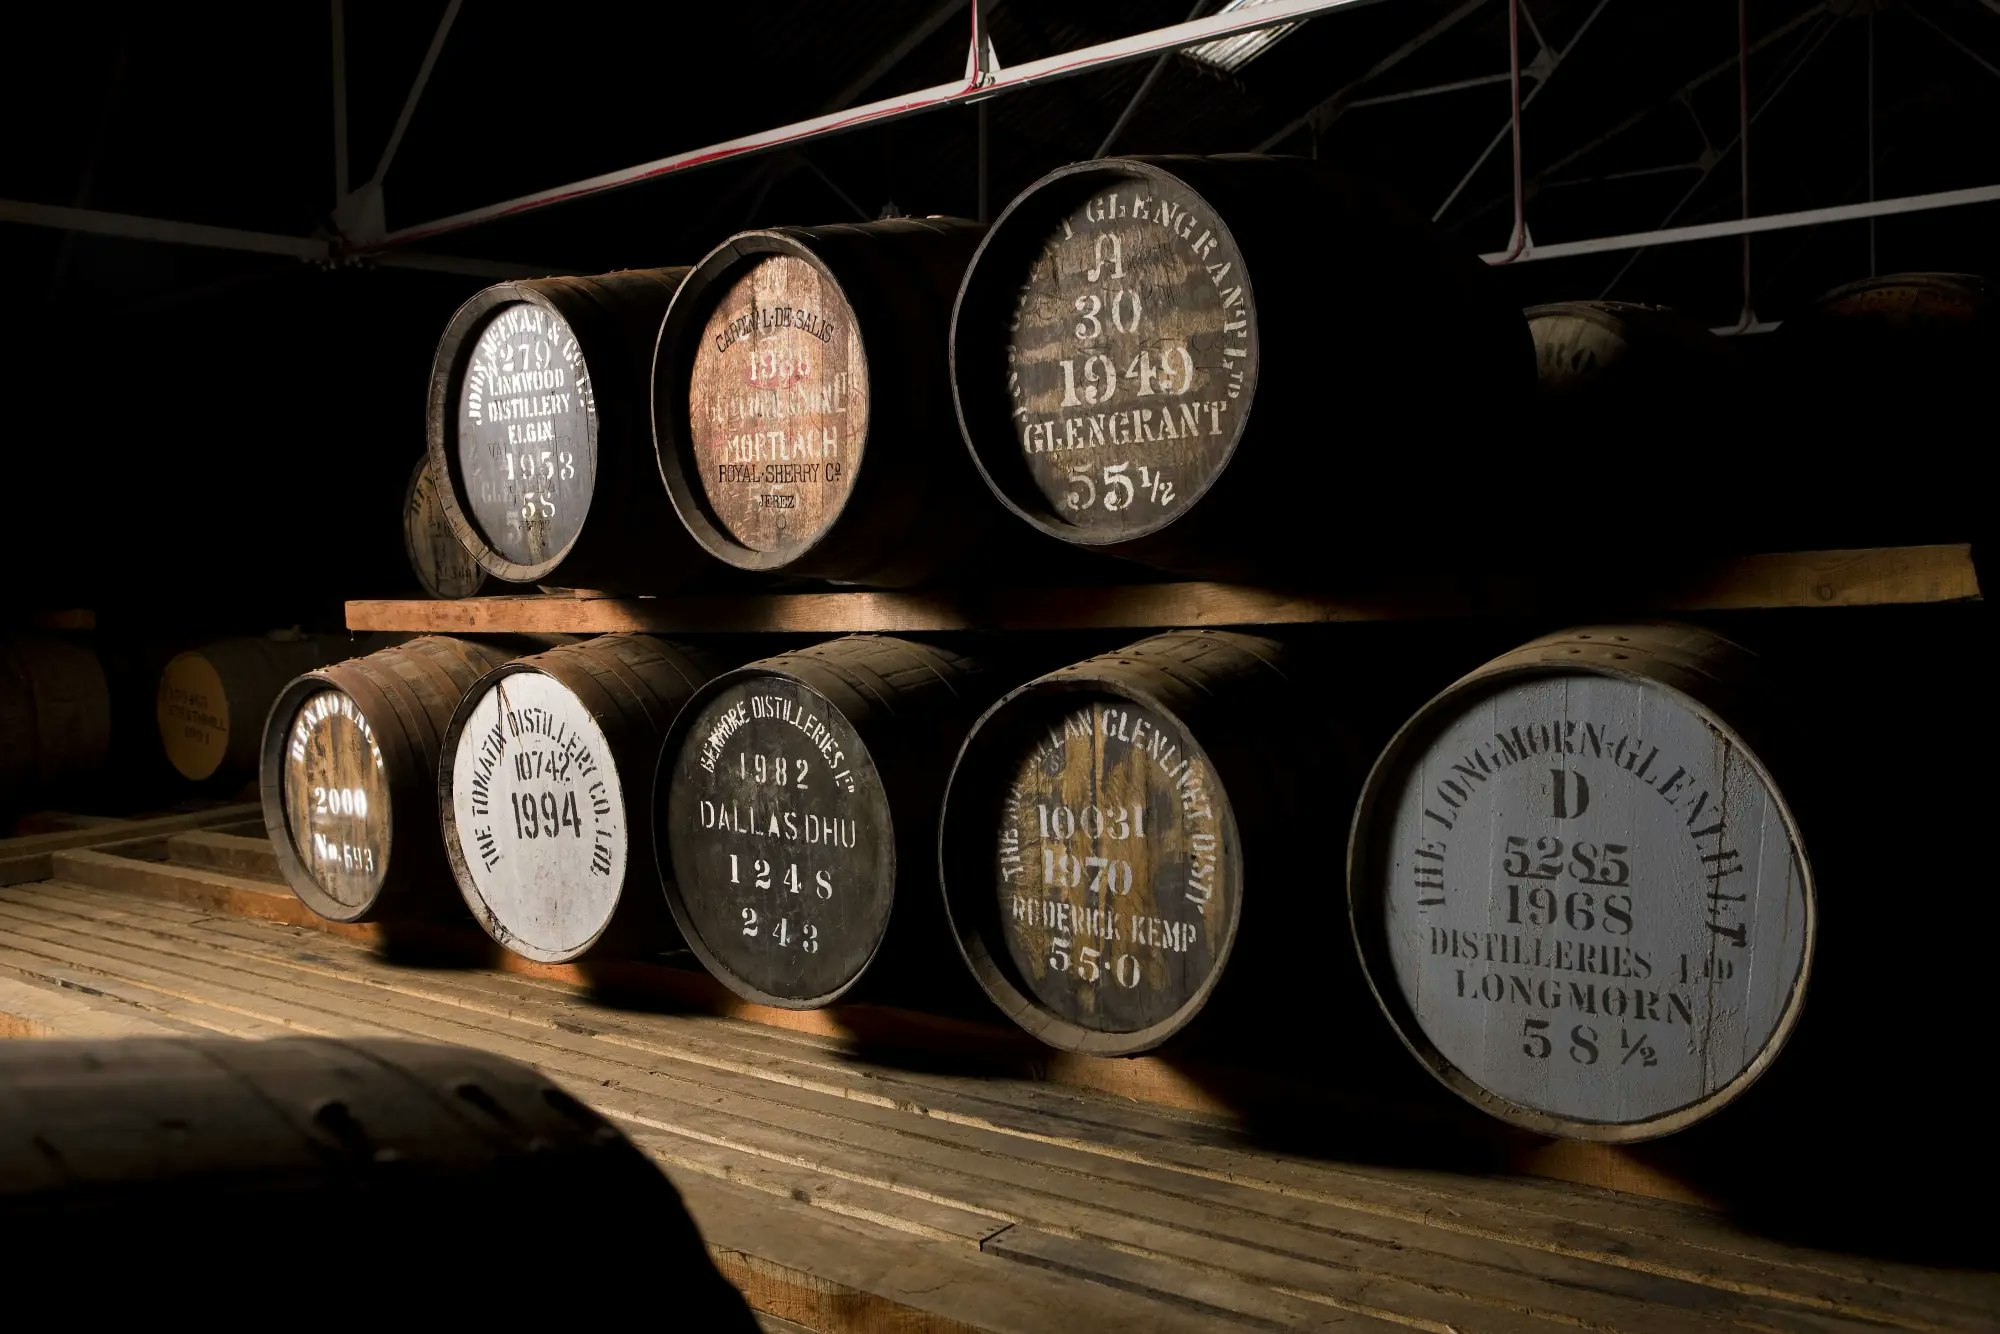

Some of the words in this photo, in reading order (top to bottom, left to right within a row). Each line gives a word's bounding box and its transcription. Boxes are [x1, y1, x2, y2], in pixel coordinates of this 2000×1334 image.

[1086, 193, 1247, 338] GLENGRANT
[1075, 288, 1142, 340] 30
[488, 367, 565, 397] LINKWOOD
[1059, 347, 1194, 408] 1949
[487, 392, 571, 422] DISTILLERY
[507, 419, 556, 445] ELGIN
[1023, 400, 1228, 454] GLENGRANT
[726, 425, 839, 463] MORTLACH
[758, 493, 795, 509] JEREZ
[506, 707, 597, 778] DISTILLERY
[700, 701, 750, 774] BENMORE
[751, 695, 845, 770] DISTILLERIES
[471, 723, 507, 818] TOMATIN
[514, 750, 571, 783] 10742
[740, 752, 809, 790] 1982
[314, 786, 368, 820] 2000
[511, 790, 583, 839] 1994
[1550, 768, 1591, 820] D
[1038, 803, 1146, 841] 10031
[473, 824, 501, 874] THE
[1043, 849, 1133, 896] 1970
[1413, 835, 1447, 914] THE
[1503, 835, 1630, 886] 5285
[741, 907, 819, 954] 243
[1012, 894, 1121, 941] RODERICK
[1131, 914, 1197, 953] KEMP
[1507, 884, 1634, 936] 1968
[1430, 926, 1653, 979] DISTILLERIES
[1455, 969, 1694, 1026] LONGMORN
